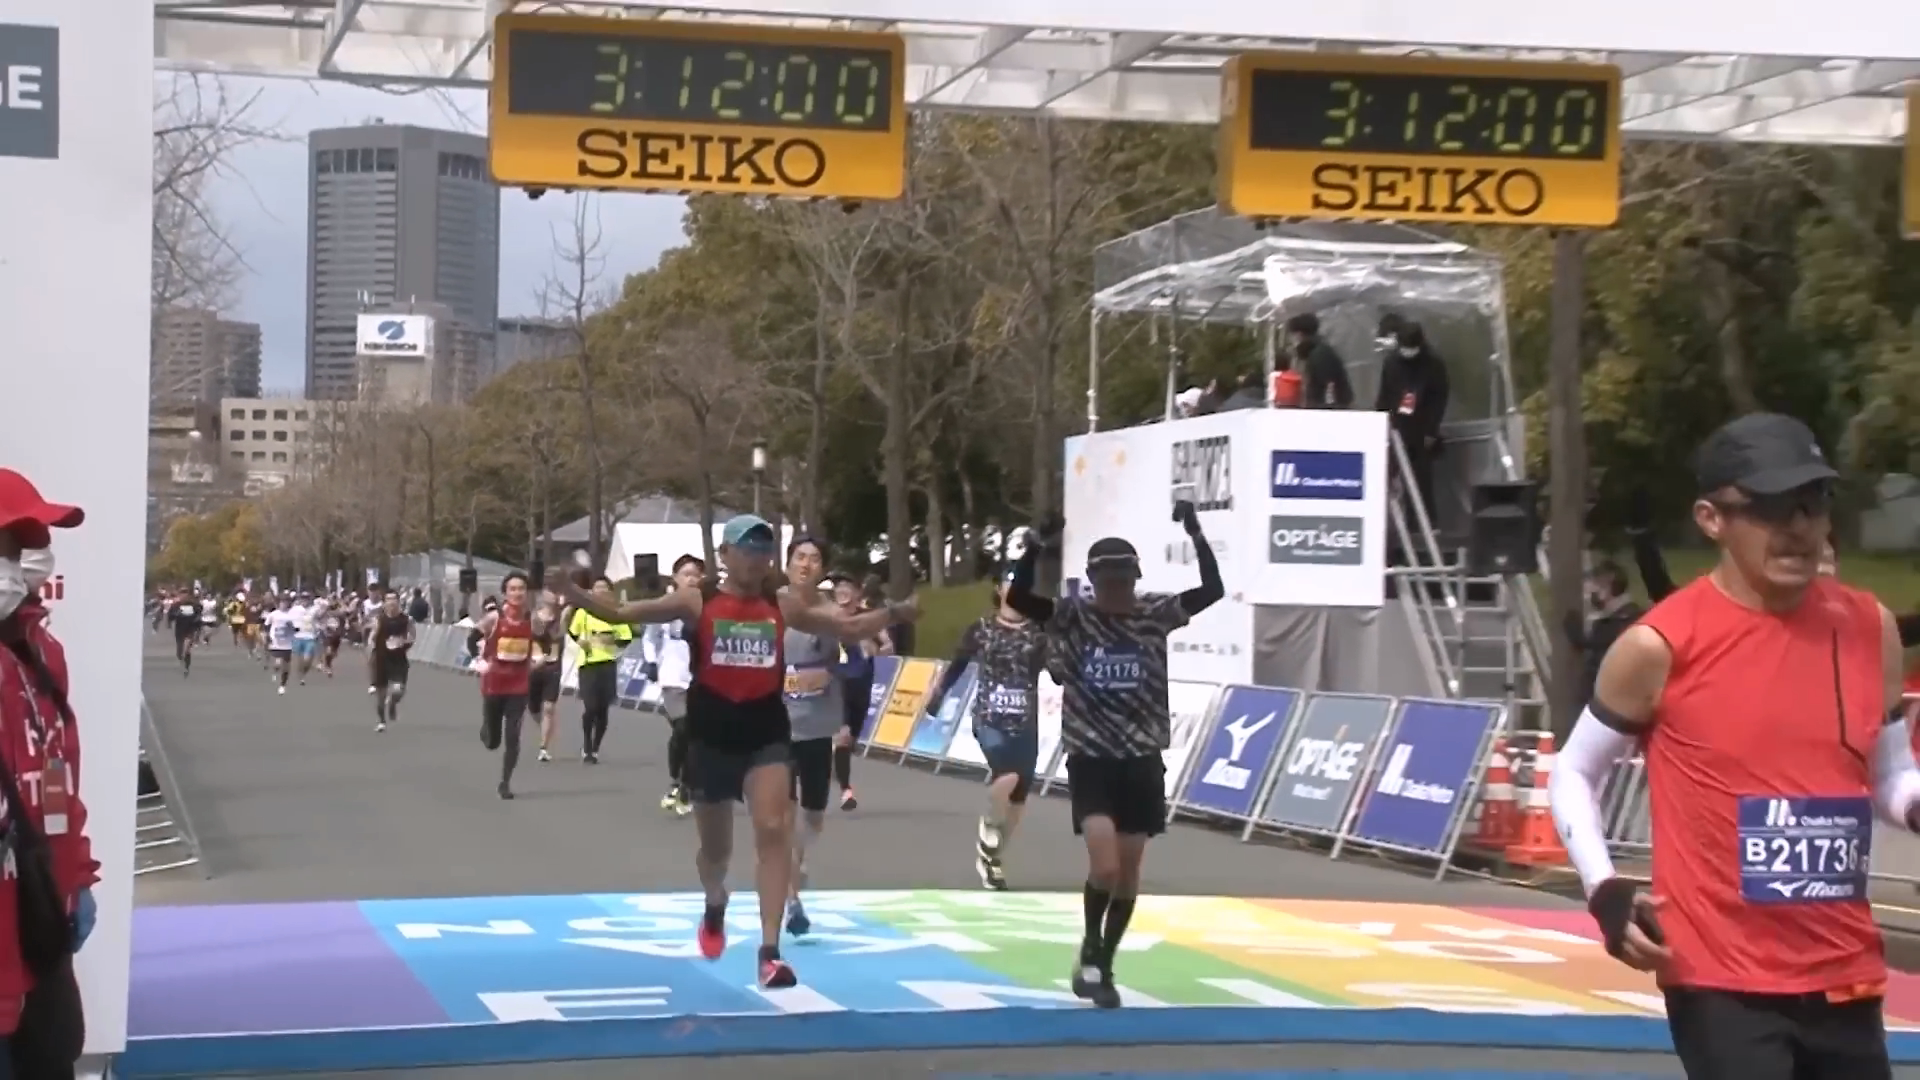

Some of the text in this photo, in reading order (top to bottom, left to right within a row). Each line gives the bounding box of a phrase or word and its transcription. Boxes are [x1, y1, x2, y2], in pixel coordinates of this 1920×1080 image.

[0, 65, 43, 110] E
[590, 43, 878, 123] 3:12:00
[1321, 80, 1597, 154] 3:12:00
[577, 128, 826, 188] SEIKO
[1311, 162, 1544, 217] SEIKO
